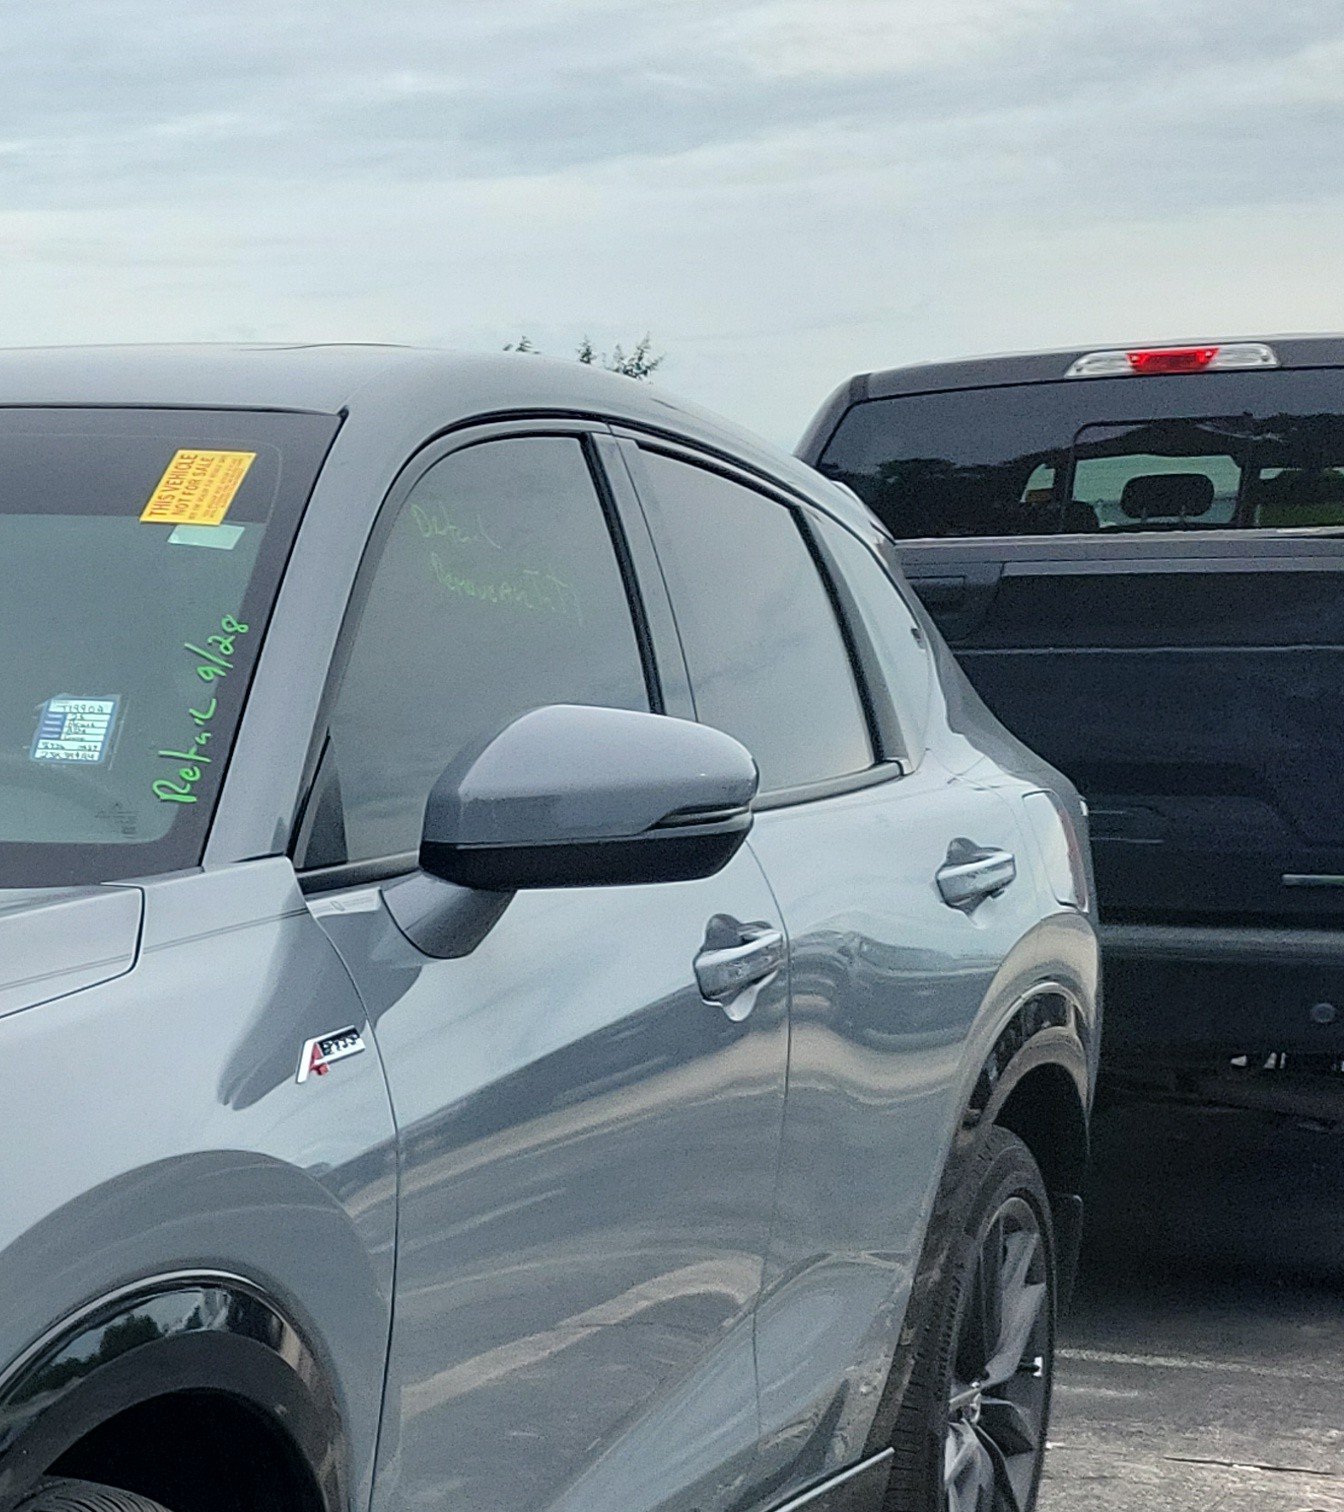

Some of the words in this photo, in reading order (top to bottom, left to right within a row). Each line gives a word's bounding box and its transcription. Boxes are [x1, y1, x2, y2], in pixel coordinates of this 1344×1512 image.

[159, 453, 198, 492] VEHICLE
[190, 456, 214, 477] SALE
[180, 478, 202, 496] FOR
[147, 493, 177, 516] THIS
[169, 497, 192, 515] NOT
